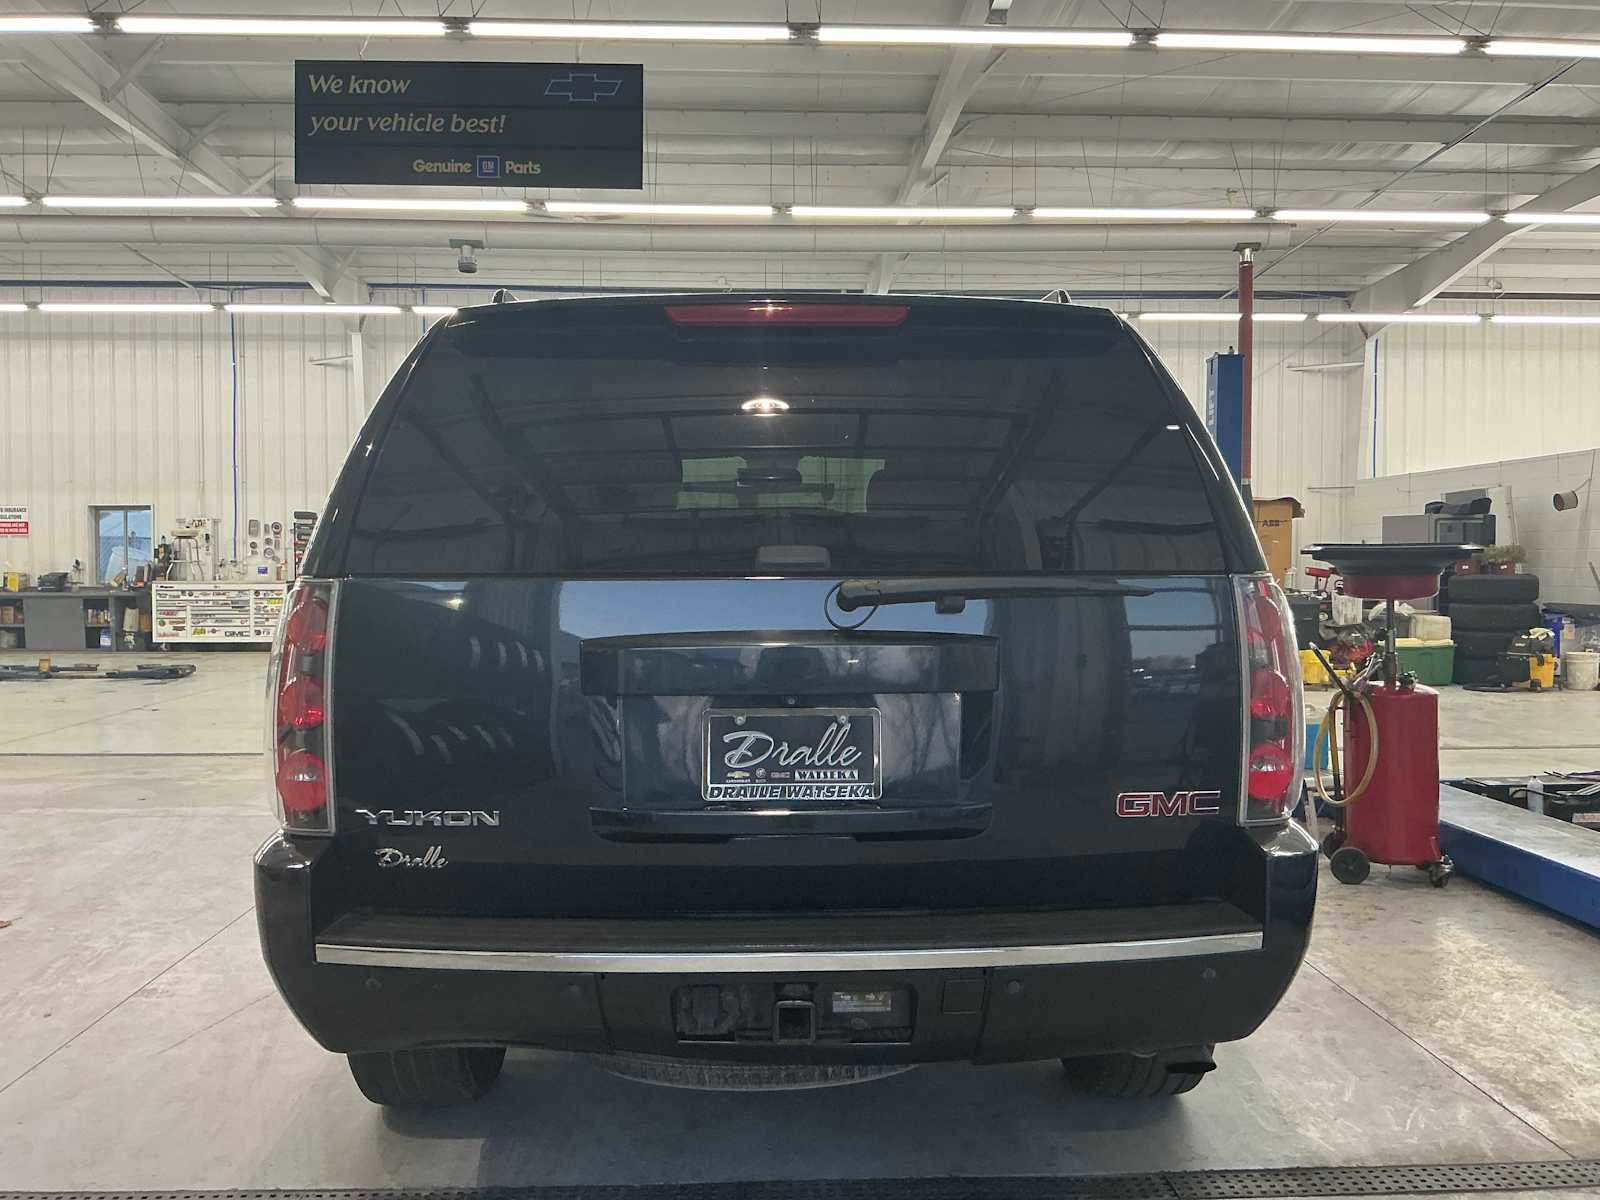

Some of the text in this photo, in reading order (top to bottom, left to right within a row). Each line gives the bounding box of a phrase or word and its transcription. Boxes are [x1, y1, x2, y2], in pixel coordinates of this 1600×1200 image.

[308, 74, 411, 94] We know
[308, 113, 506, 136] your vehicle best!
[413, 159, 472, 173] Genuine
[505, 161, 541, 174] Parts
[723, 722, 862, 768] Dralle
[795, 770, 858, 780] WATSEKA
[709, 786, 874, 799] DRALLE WATSEKA
[1116, 790, 1221, 817] GMC
[355, 809, 500, 826] YUKON
[375, 845, 449, 869] Dralle
